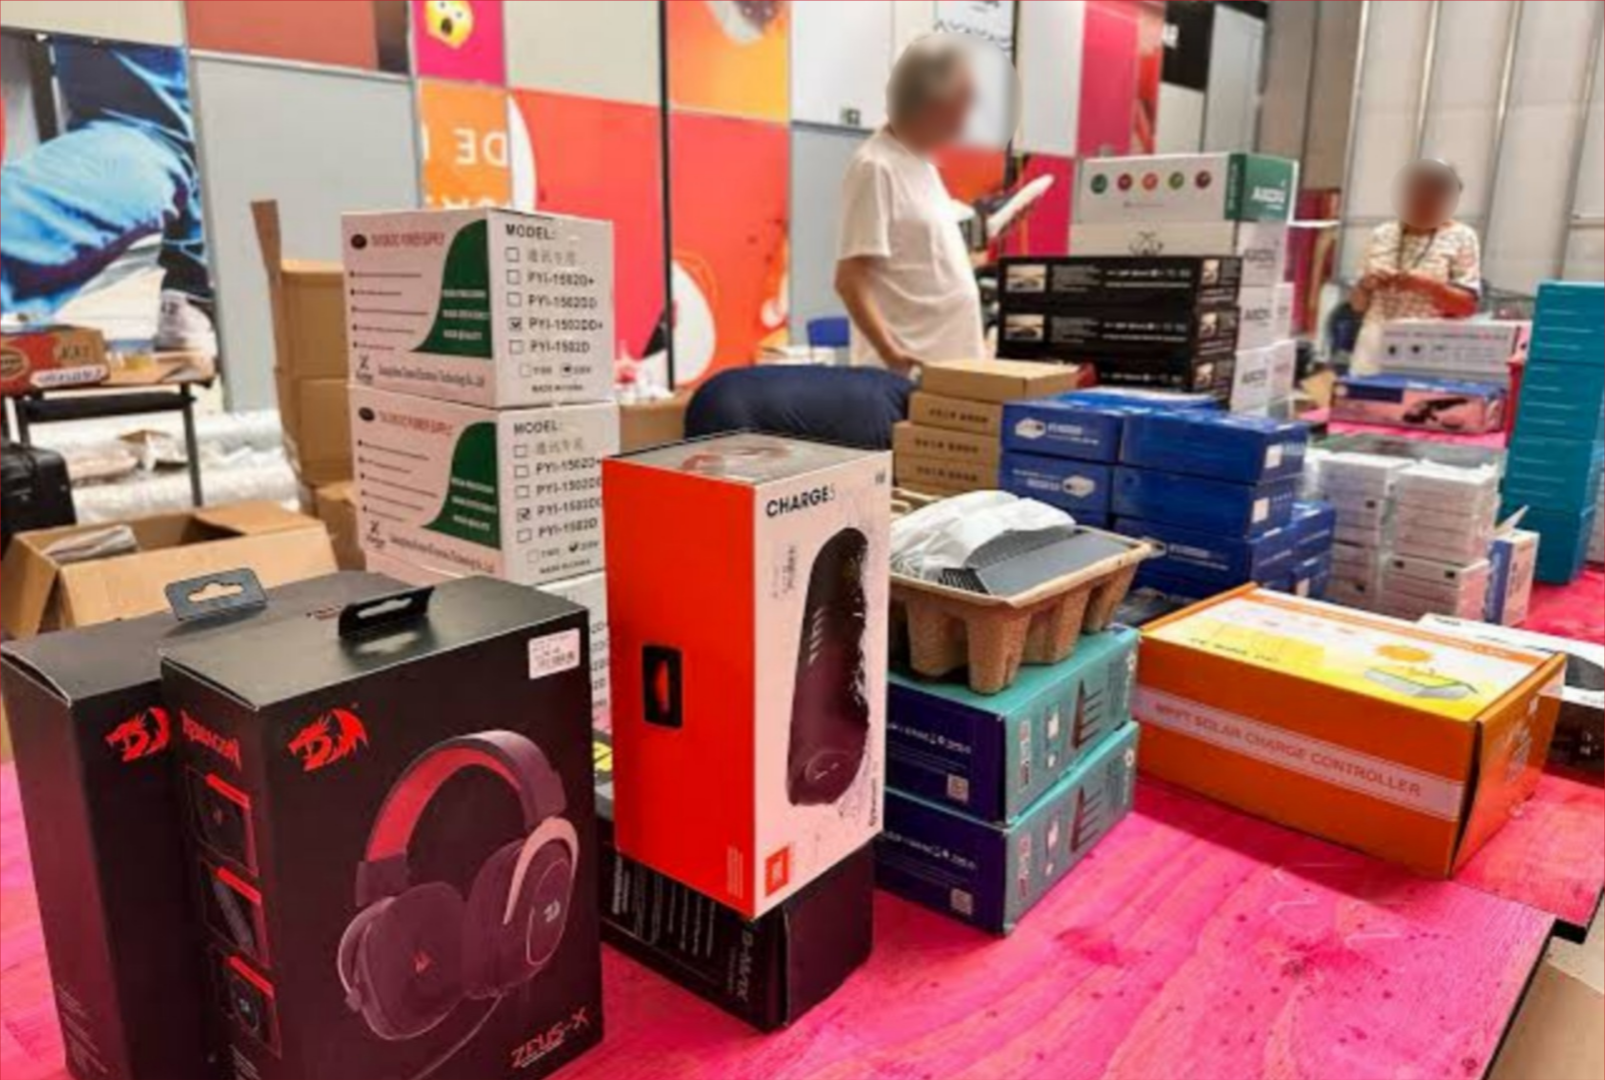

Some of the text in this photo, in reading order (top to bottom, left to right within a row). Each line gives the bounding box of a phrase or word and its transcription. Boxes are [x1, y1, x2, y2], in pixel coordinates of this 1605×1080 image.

[506, 224, 555, 240] MODEL:
[1195, 715, 1243, 739] SOLAR
[1245, 732, 1306, 760] CHARGE
[1311, 753, 1421, 797] CONTROLLER
